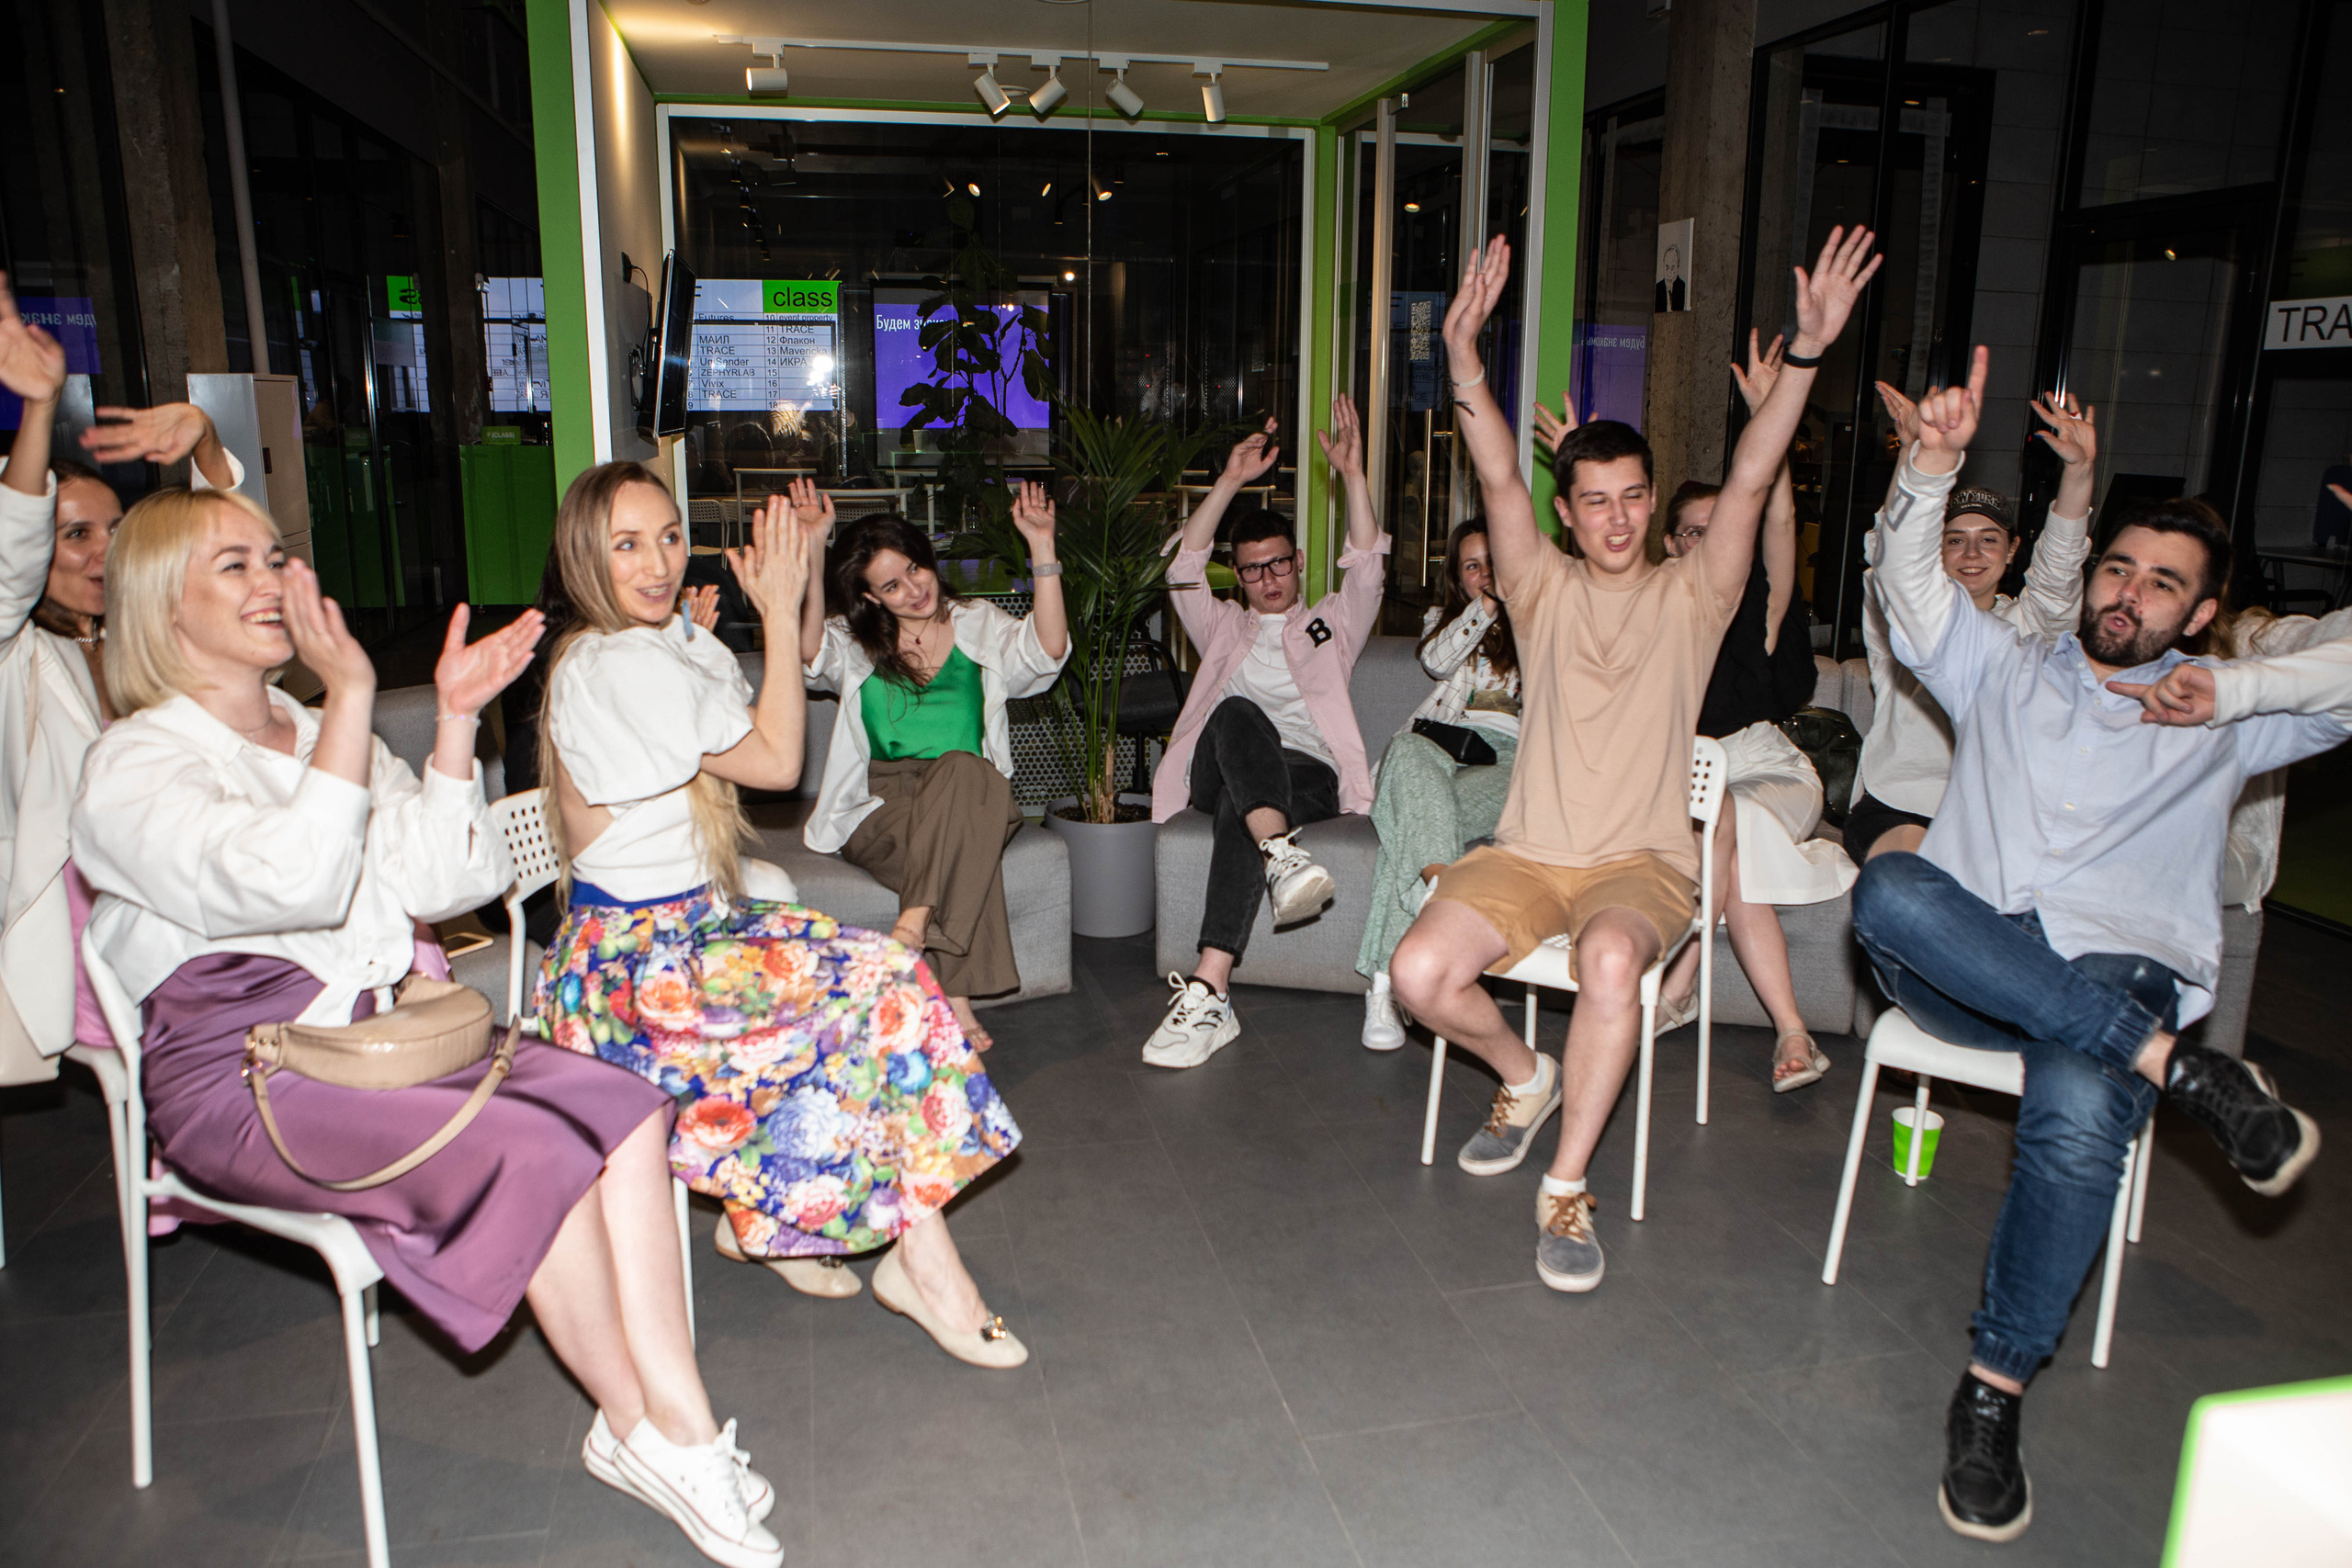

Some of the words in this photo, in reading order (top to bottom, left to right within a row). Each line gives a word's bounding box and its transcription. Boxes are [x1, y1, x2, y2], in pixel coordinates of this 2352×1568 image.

[773, 287, 832, 307] class
[698, 313, 734, 321] Futures
[876, 314, 910, 332] Будем
[2278, 303, 2352, 343] TRA
[780, 325, 815, 333] TRACE
[699, 335, 729, 344] МАИЛ
[779, 335, 815, 344] Флакон
[700, 346, 735, 355] TRACE
[767, 346, 776, 355] 13
[780, 346, 827, 355] Mavericka
[700, 357, 749, 367] UniSender
[780, 357, 808, 366] ИКРА
[701, 368, 755, 377] ZEPHYRLAB
[701, 379, 725, 388] Vivix
[703, 390, 737, 399] TRACE
[1306, 617, 1333, 649] B
